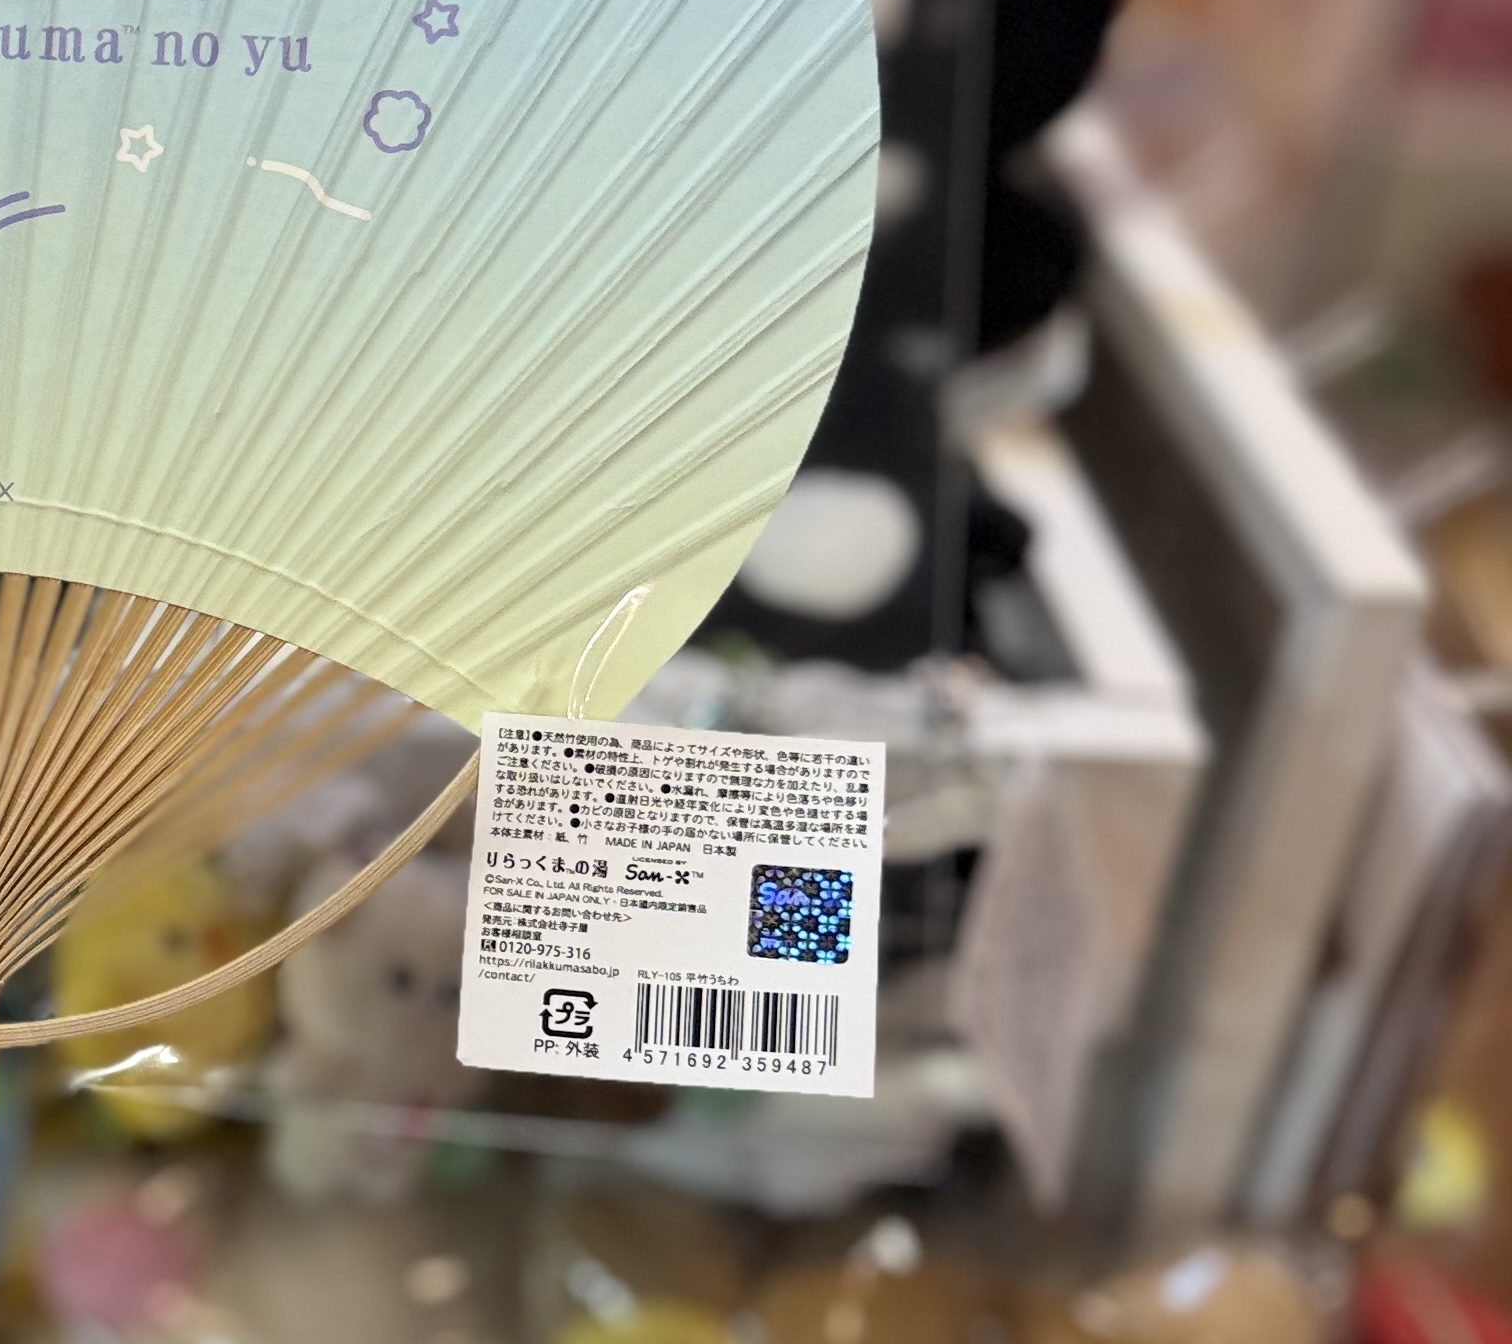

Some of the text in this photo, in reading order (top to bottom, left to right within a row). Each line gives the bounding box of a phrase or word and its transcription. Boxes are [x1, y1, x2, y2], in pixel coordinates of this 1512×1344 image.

[151, 30, 220, 68] no
[241, 34, 312, 77] yu
[605, 836, 637, 849] MADE
[641, 839, 652, 850] IN
[656, 840, 691, 853] JAPAN
[702, 843, 737, 857] 日本製
[483, 886, 504, 897] FOR
[506, 888, 533, 899] SALE
[534, 891, 545, 900] IN
[546, 891, 581, 903] JAPAN
[582, 895, 611, 905] ONLY
[568, 881, 580, 891] All
[582, 882, 614, 894] Rights
[498, 940, 592, 960] 0120-975-316
[477, 968, 537, 983] /contact/
[478, 954, 620, 978] https://rilakkumasabo.jp
[637, 969, 740, 986] RLY-105 平竹うちわ
[554, 1000, 591, 1027] プラ
[564, 1039, 601, 1060] 外装
